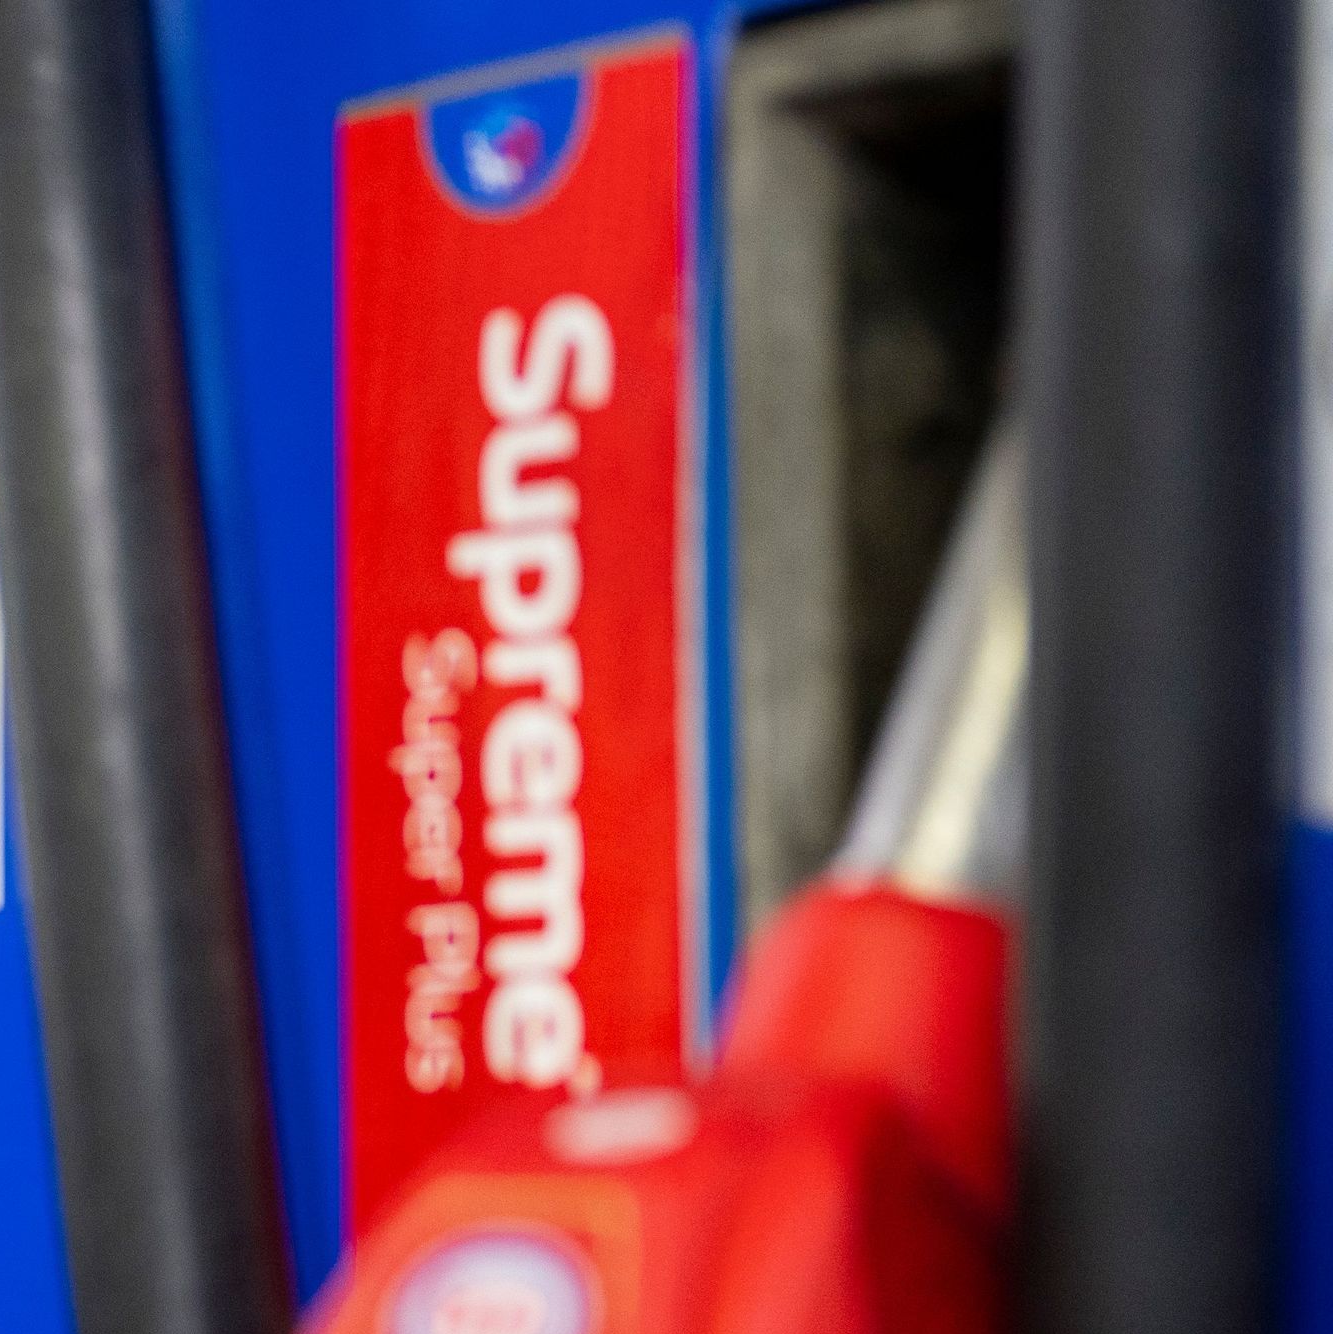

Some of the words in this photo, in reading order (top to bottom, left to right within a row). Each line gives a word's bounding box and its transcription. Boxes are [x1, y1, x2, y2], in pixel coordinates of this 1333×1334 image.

[388, 626, 478, 894] Super
[446, 292, 615, 1088] Supreme
[405, 900, 481, 1094] Plus
